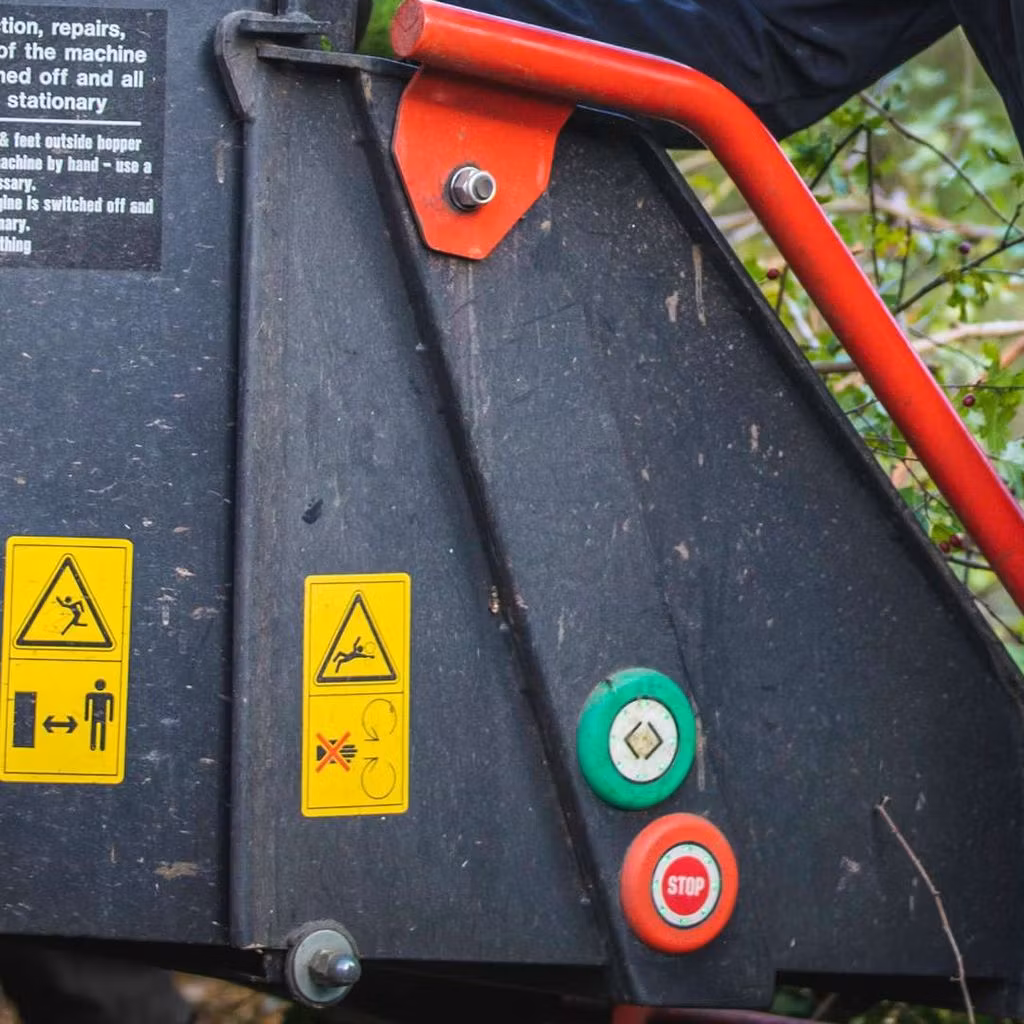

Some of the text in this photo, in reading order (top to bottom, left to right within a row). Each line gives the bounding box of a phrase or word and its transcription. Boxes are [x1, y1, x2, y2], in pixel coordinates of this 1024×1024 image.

[0, 16, 126, 41] tion, repairs,
[0, 42, 148, 63] of the machine
[39, 68, 69, 86] off
[76, 69, 114, 87] and
[121, 70, 144, 88] all
[7, 92, 108, 114] stationary
[14, 132, 41, 149] feet
[45, 133, 93, 150] outside
[97, 134, 142, 153] hopper
[47, 155, 64, 174] by
[67, 156, 99, 173] hand
[116, 160, 139, 174] use
[143, 161, 153, 175] a
[26, 195, 39, 212] is
[43, 195, 103, 213] switched
[106, 197, 126, 214] off
[129, 198, 154, 215] and
[667, 875, 705, 896] STOP
